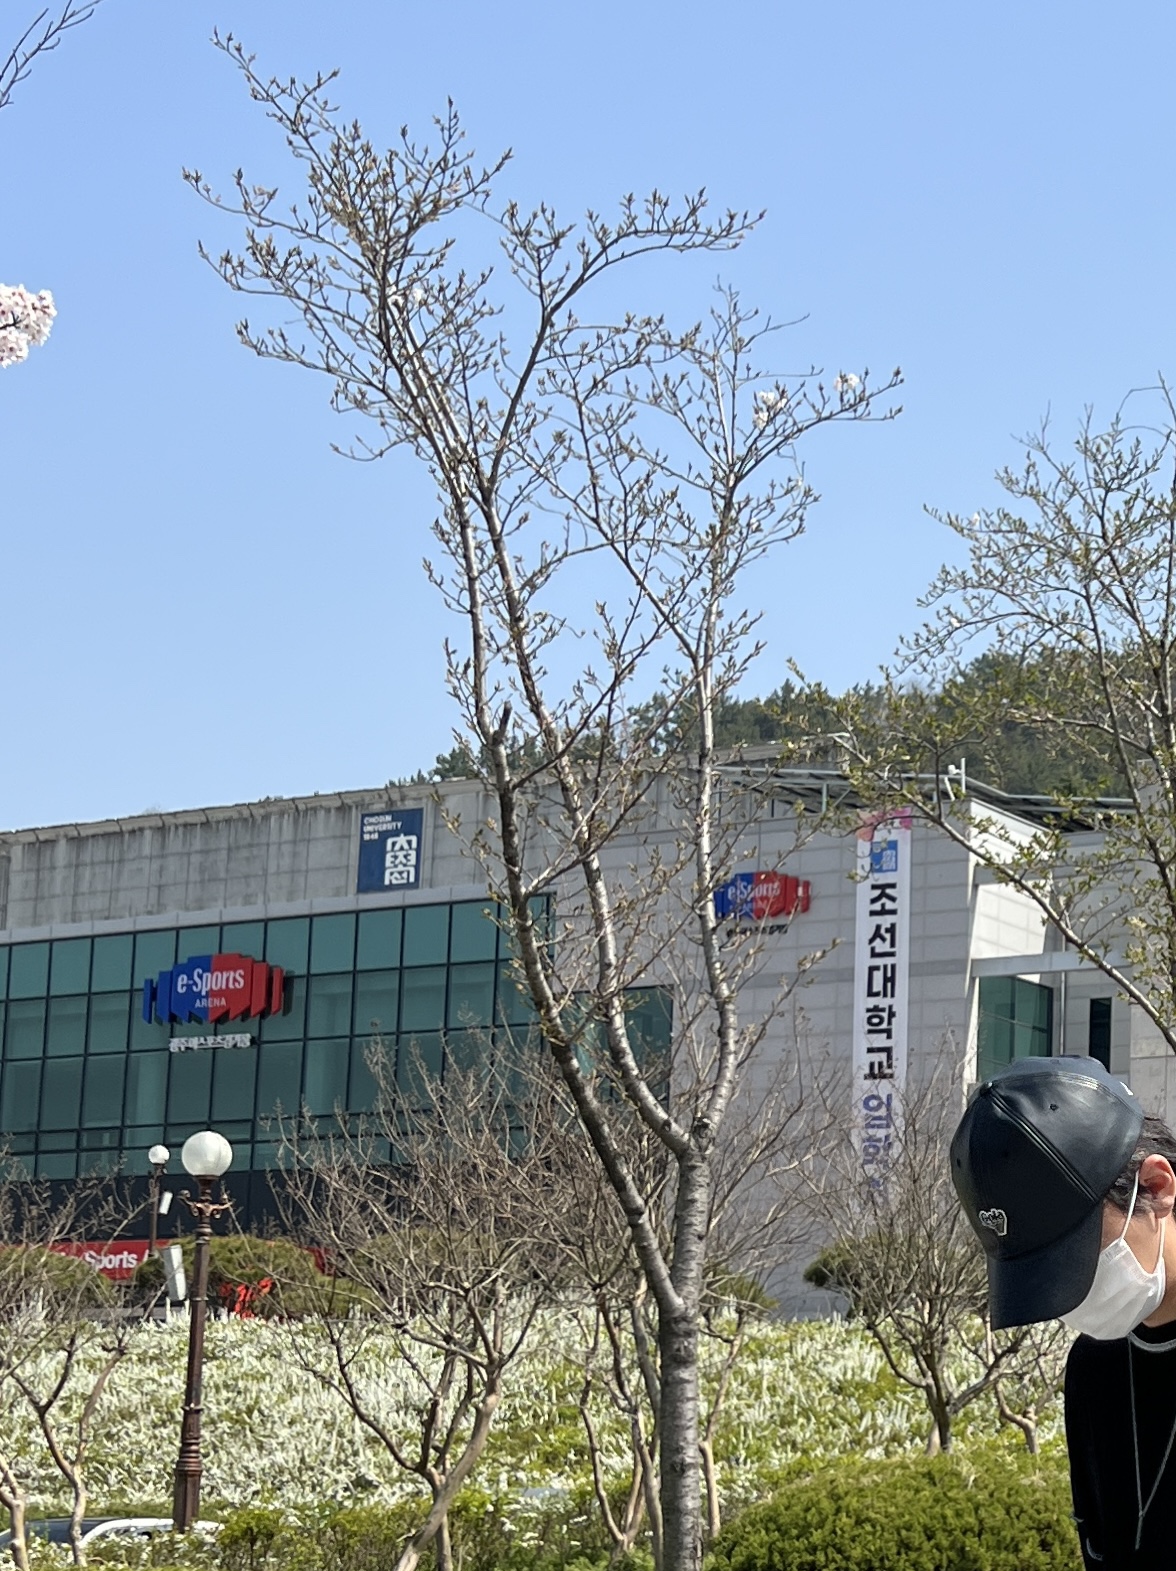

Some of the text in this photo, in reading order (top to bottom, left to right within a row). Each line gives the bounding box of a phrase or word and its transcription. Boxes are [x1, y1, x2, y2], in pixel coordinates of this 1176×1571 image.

[177, 968, 245, 996] e-Sports
[863, 882, 898, 1080] 조선대학교
[195, 997, 227, 1008] ARENA
